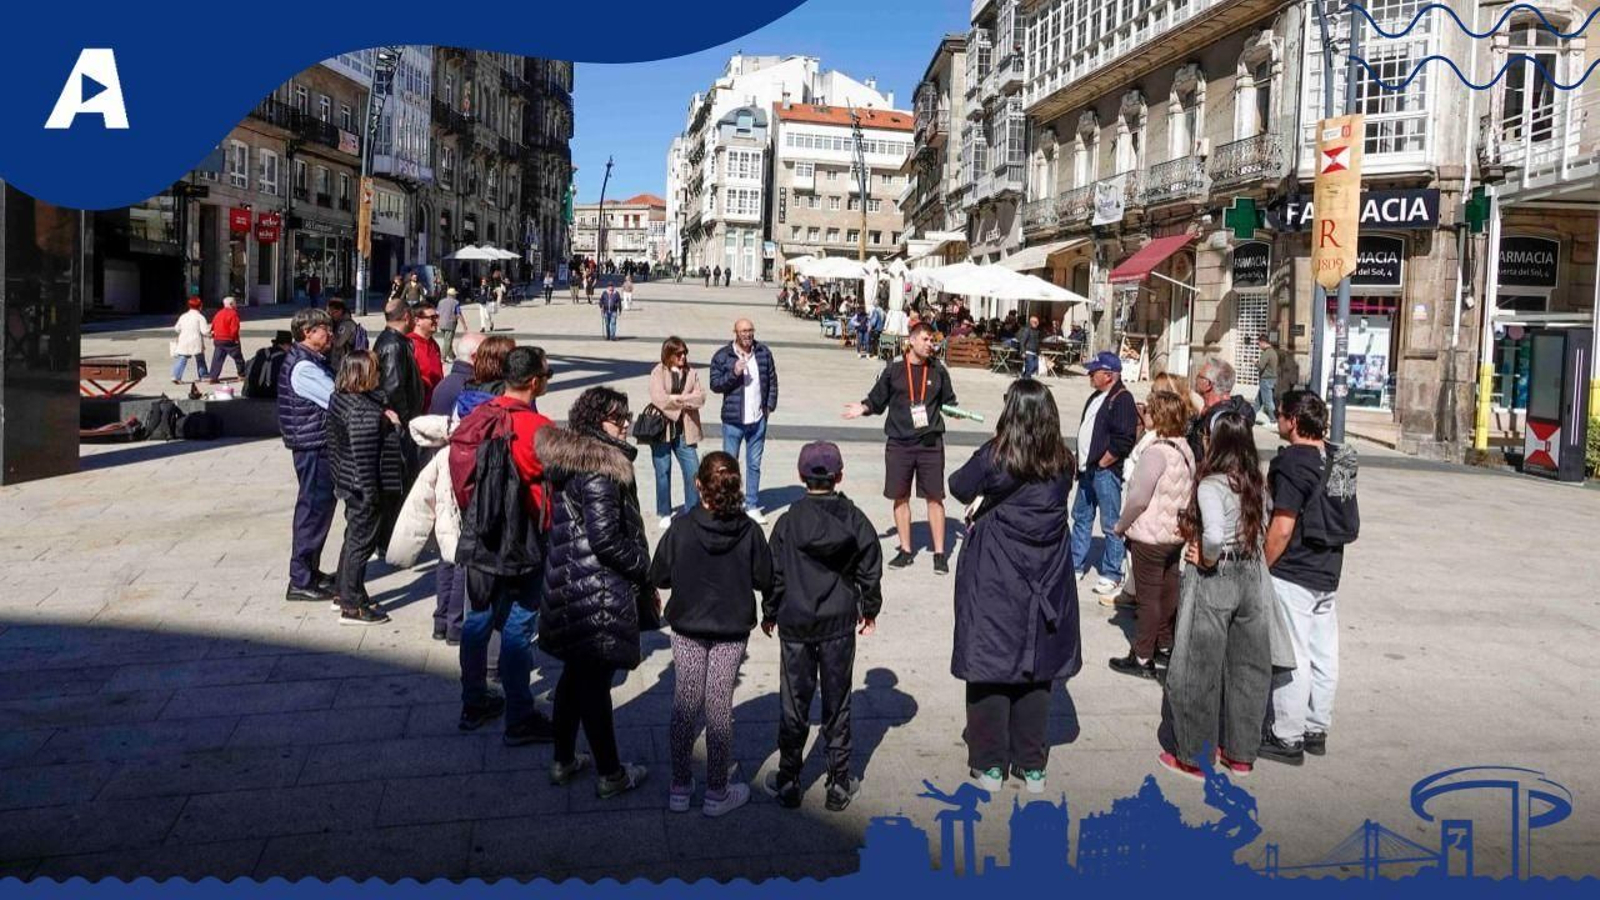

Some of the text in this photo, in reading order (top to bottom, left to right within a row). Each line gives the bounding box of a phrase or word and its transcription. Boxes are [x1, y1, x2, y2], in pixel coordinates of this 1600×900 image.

[1319, 219, 1342, 248] R
[1499, 251, 1554, 264] ARMACIA
[1317, 258, 1344, 271] 1809
